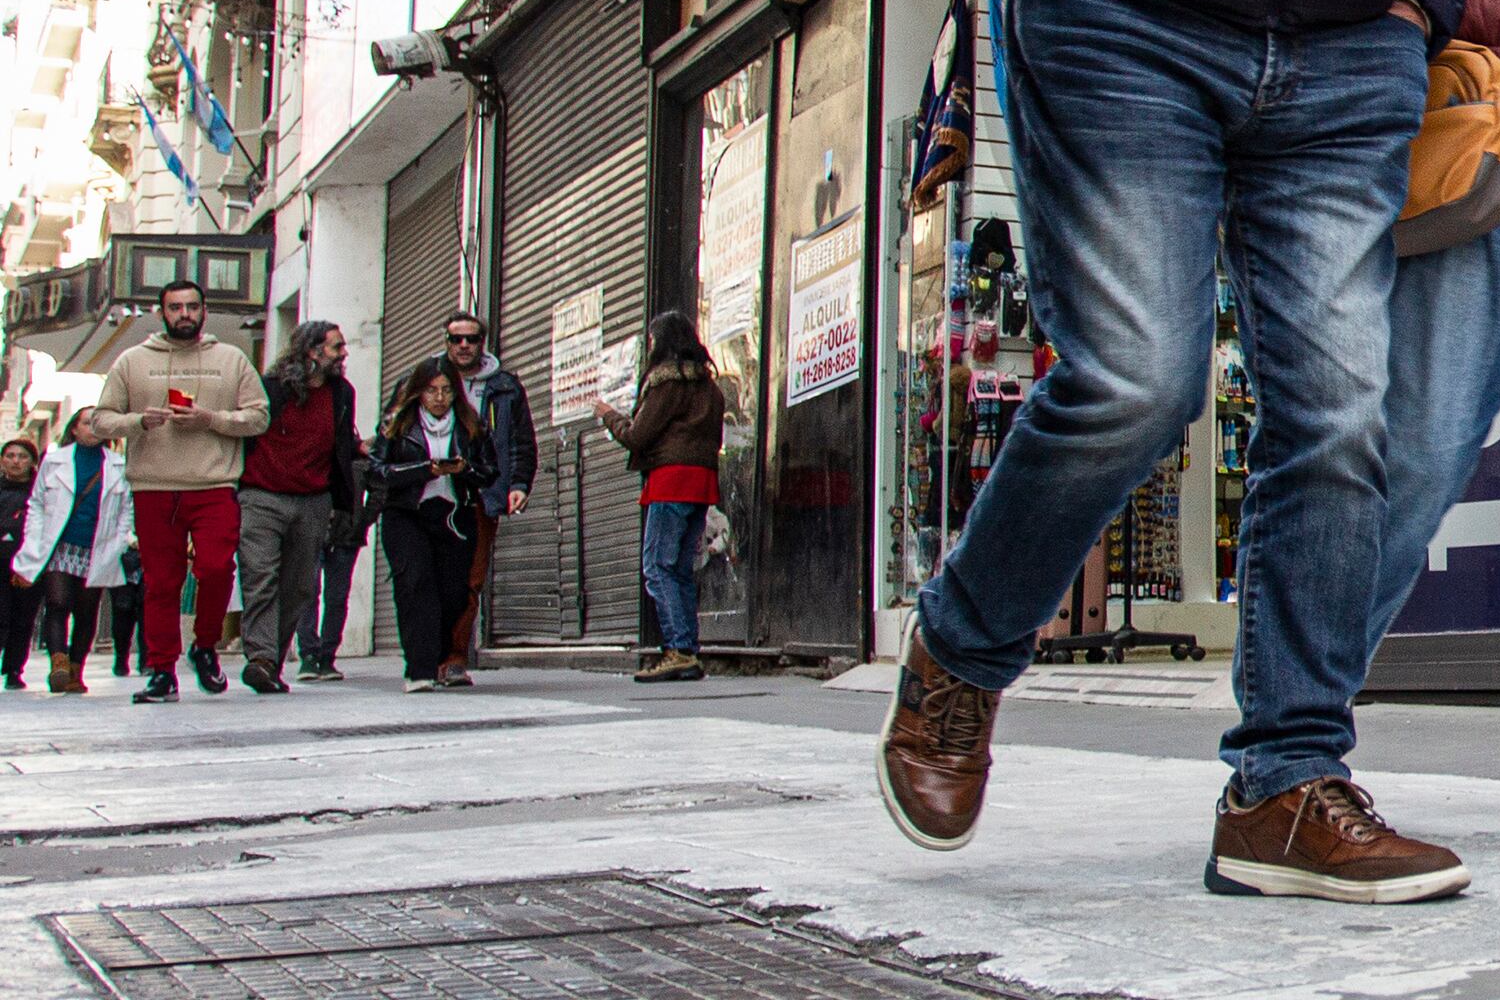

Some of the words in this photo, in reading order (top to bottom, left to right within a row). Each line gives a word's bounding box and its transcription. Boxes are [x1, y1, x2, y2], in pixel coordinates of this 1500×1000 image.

[802, 292, 851, 335] ALQUILA
[796, 318, 857, 364] 4327-0022
[802, 346, 857, 387] 11-2618-8258
